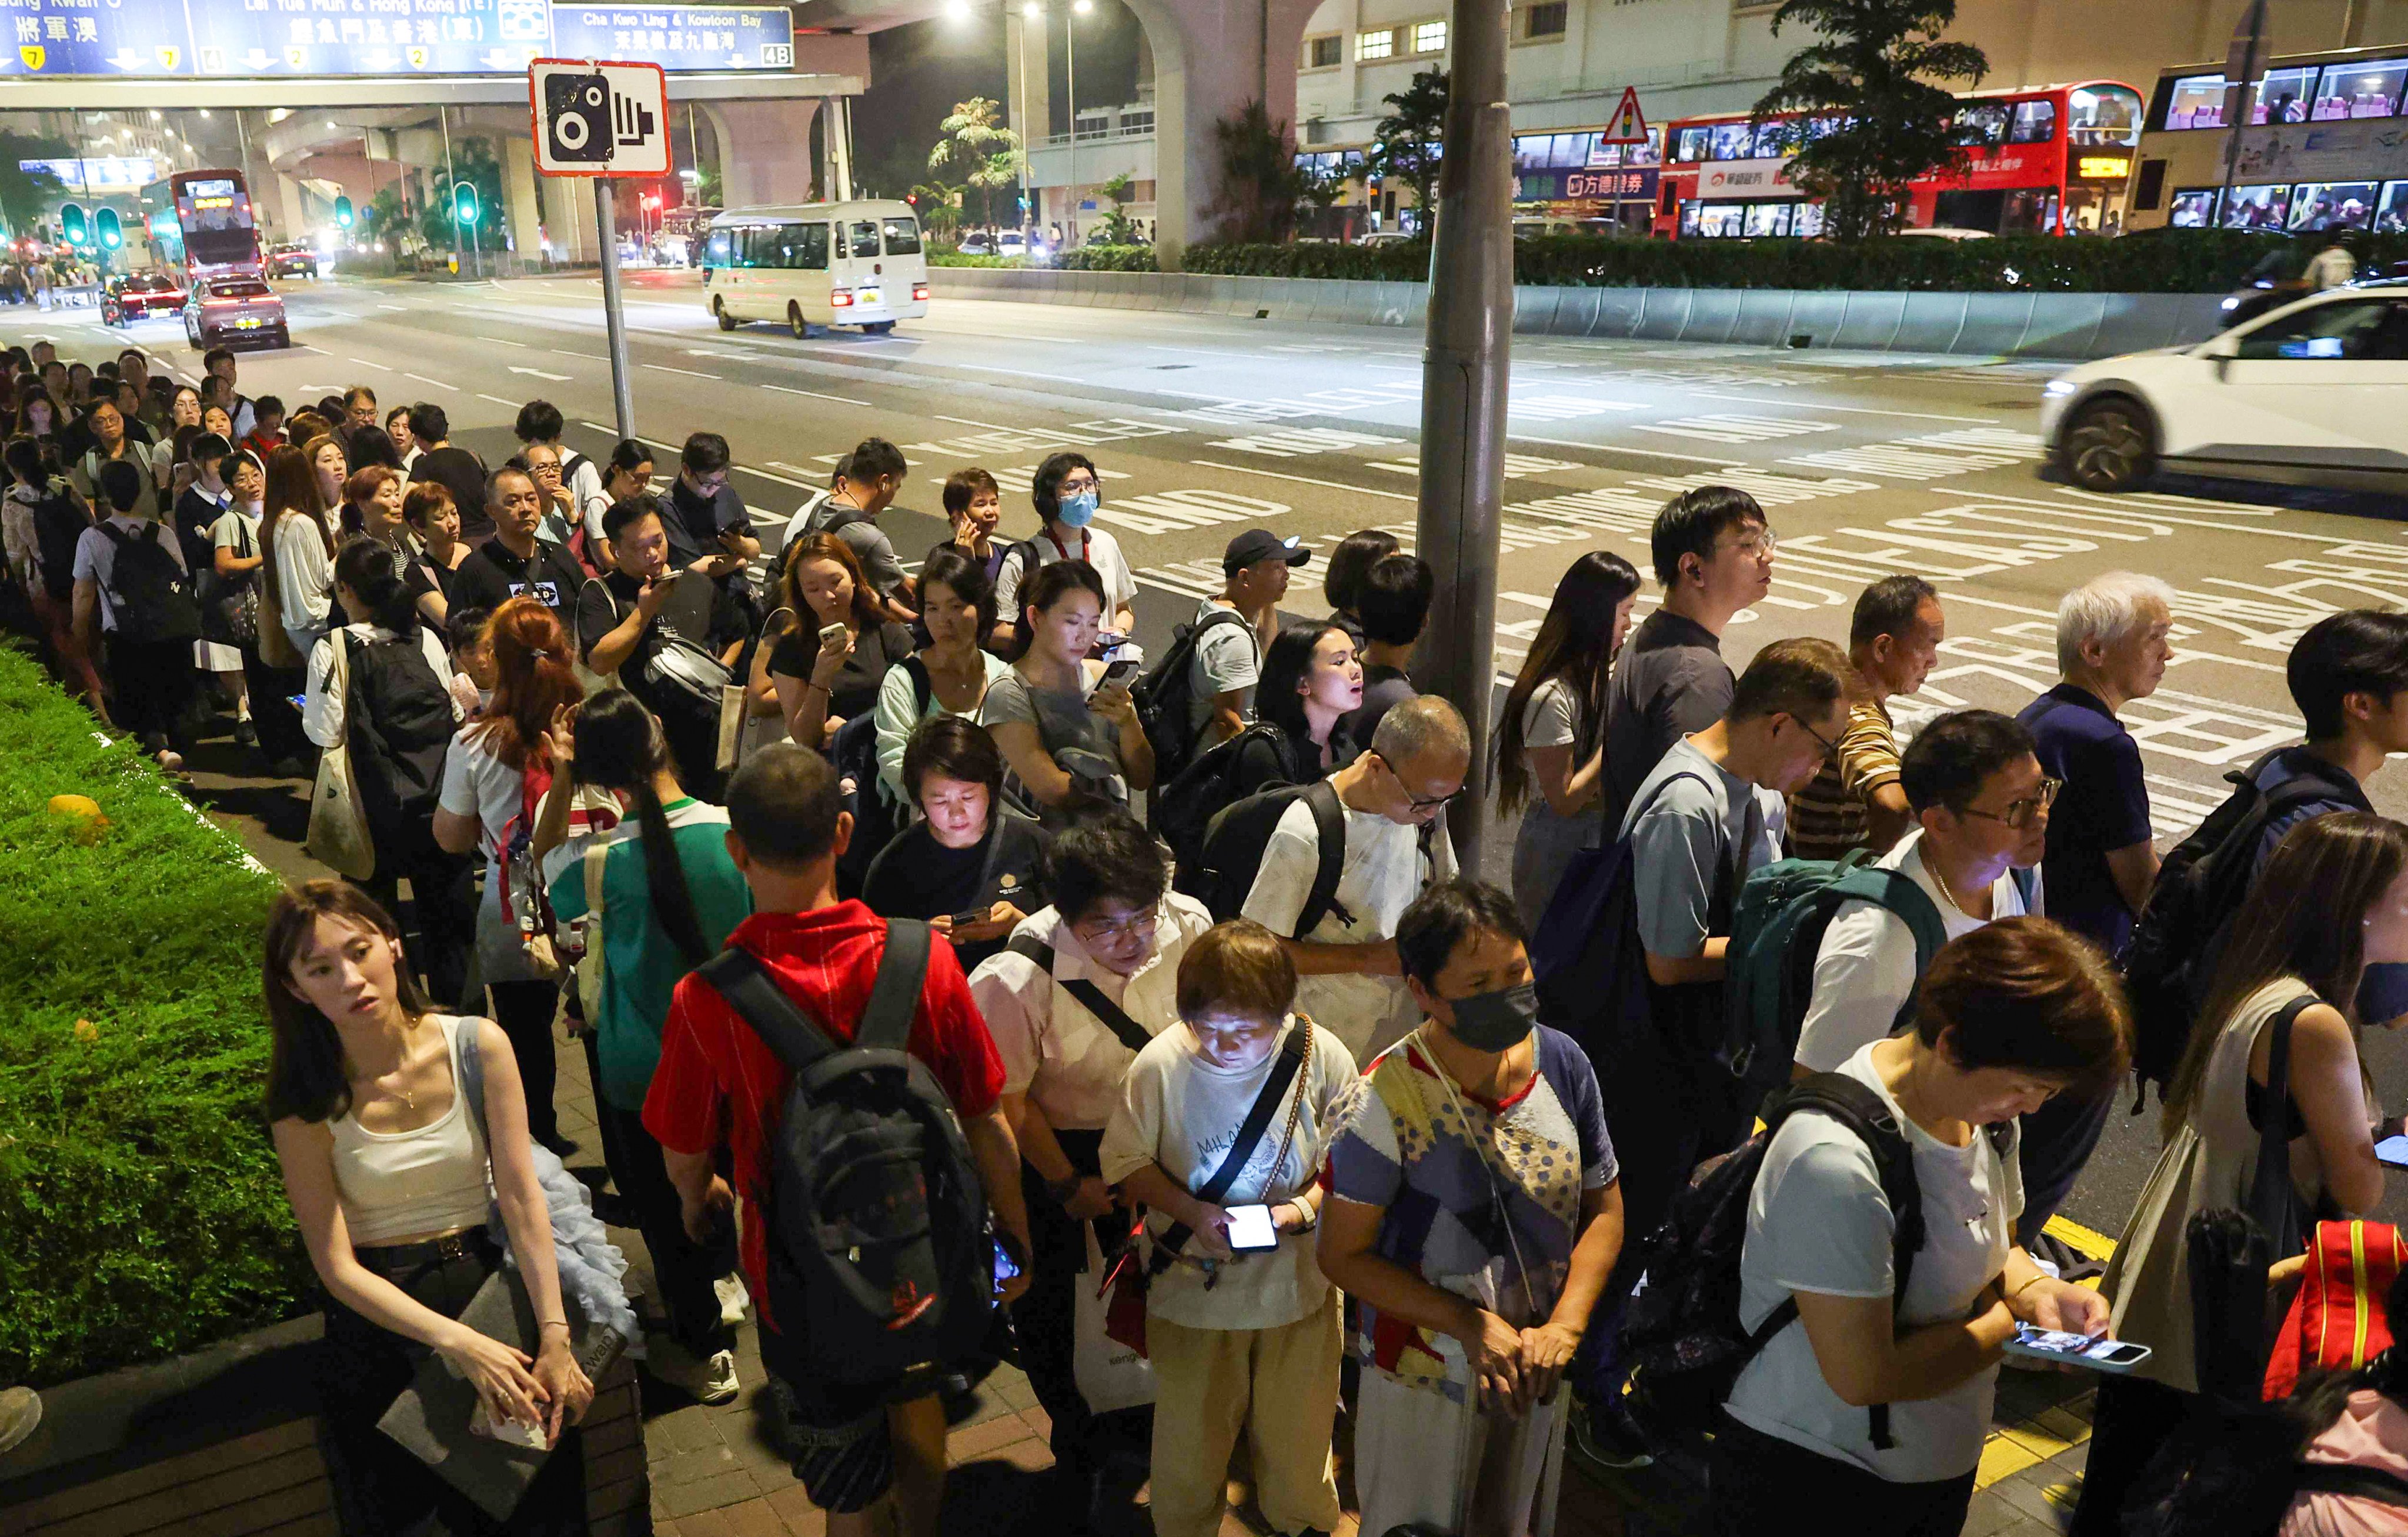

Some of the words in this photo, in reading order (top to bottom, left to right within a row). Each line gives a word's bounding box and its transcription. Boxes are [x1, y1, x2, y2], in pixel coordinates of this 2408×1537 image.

[245, 0, 269, 11] Lei
[277, 0, 306, 12] Yue
[312, 0, 345, 12] Mun
[369, 0, 410, 15] Hong
[416, 0, 455, 14] Kong
[15, 16, 99, 43] 將軍澳
[583, 12, 608, 26] Cha
[613, 14, 638, 26] Kwo
[643, 14, 668, 28] Ling
[672, 14, 682, 26] &
[687, 14, 736, 26] Kowloon
[741, 15, 762, 29] Bay
[28, 51, 38, 65] 7
[162, 51, 173, 65] 7
[291, 50, 301, 64] 2
[413, 50, 423, 64] 2
[765, 46, 790, 64] 4B
[1630, 413, 1843, 443] AND
[899, 432, 1071, 457] YUE
[1205, 427, 1409, 456] MUN
[1774, 445, 2022, 481] HONG
[1090, 489, 1292, 535] AND
